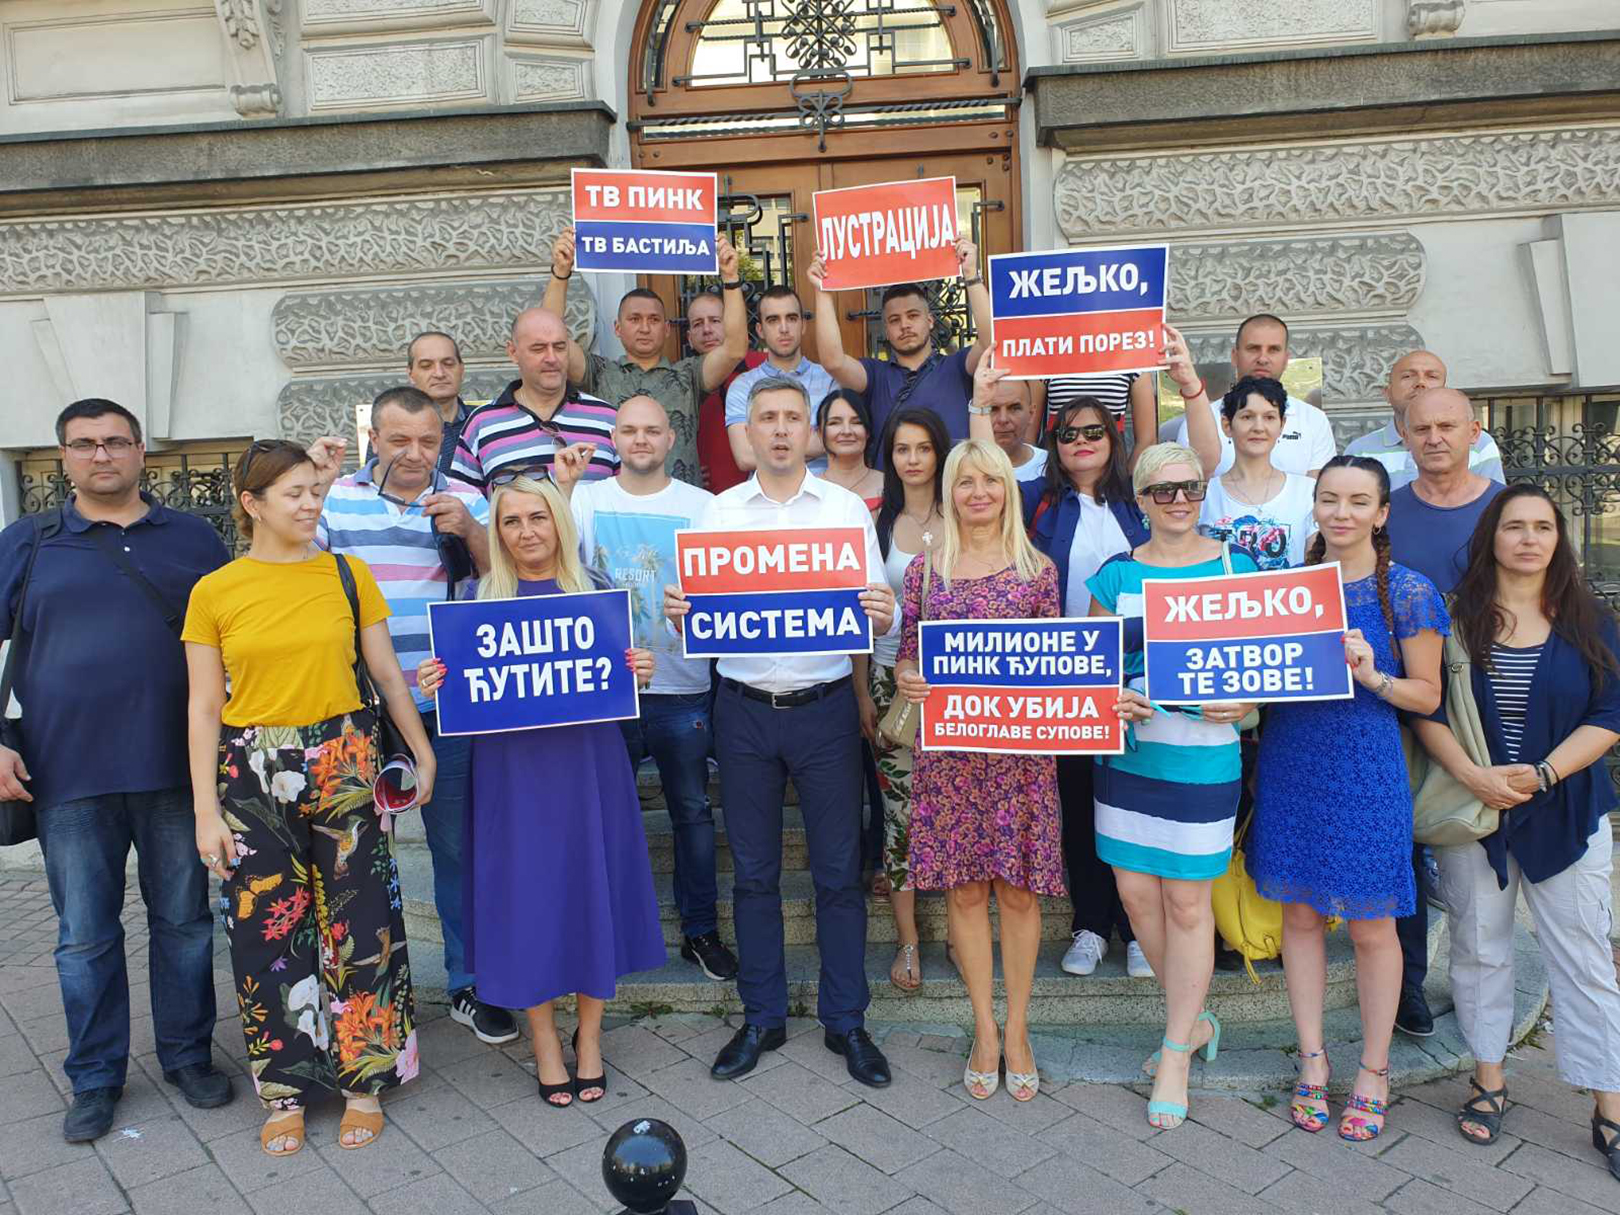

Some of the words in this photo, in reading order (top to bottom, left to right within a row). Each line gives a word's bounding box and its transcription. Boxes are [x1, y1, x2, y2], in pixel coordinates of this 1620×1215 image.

[585, 185, 621, 207] ТВ
[628, 185, 703, 211] ПИНК
[582, 237, 606, 253] ТВ
[613, 237, 711, 256] БАСТИЉА
[820, 203, 956, 262] ЛУСТРАЦИЈА
[1008, 262, 1149, 299] ЖЕЉКО,
[1002, 335, 1073, 358] ПЛАТИ
[1079, 329, 1155, 354] ПОРЕЗ!
[683, 541, 861, 577] ПРОМЕНА
[615, 566, 657, 583] RESORT
[1164, 586, 1324, 623] ЖЕЉКО,
[476, 615, 595, 659] ЗАШТО
[691, 607, 862, 640] СИСТЕМА
[944, 632, 1075, 653] МИЛИОНЕ
[1082, 630, 1100, 652] У
[933, 656, 1001, 675] ПИНК
[1006, 656, 1112, 677] ЋУПОВЕ,
[1185, 642, 1304, 671] ЗАТВОР
[463, 656, 612, 703] ЋУТИТЕ?
[1177, 671, 1215, 695] ТЕ
[1222, 667, 1314, 693] ЗОВЕ!
[943, 694, 1001, 720] ДОК
[1007, 696, 1099, 719] УБИЈА
[934, 723, 1032, 740] БЕЛОГЛАВЕ
[1036, 725, 1110, 740] СУПОВЕ!
